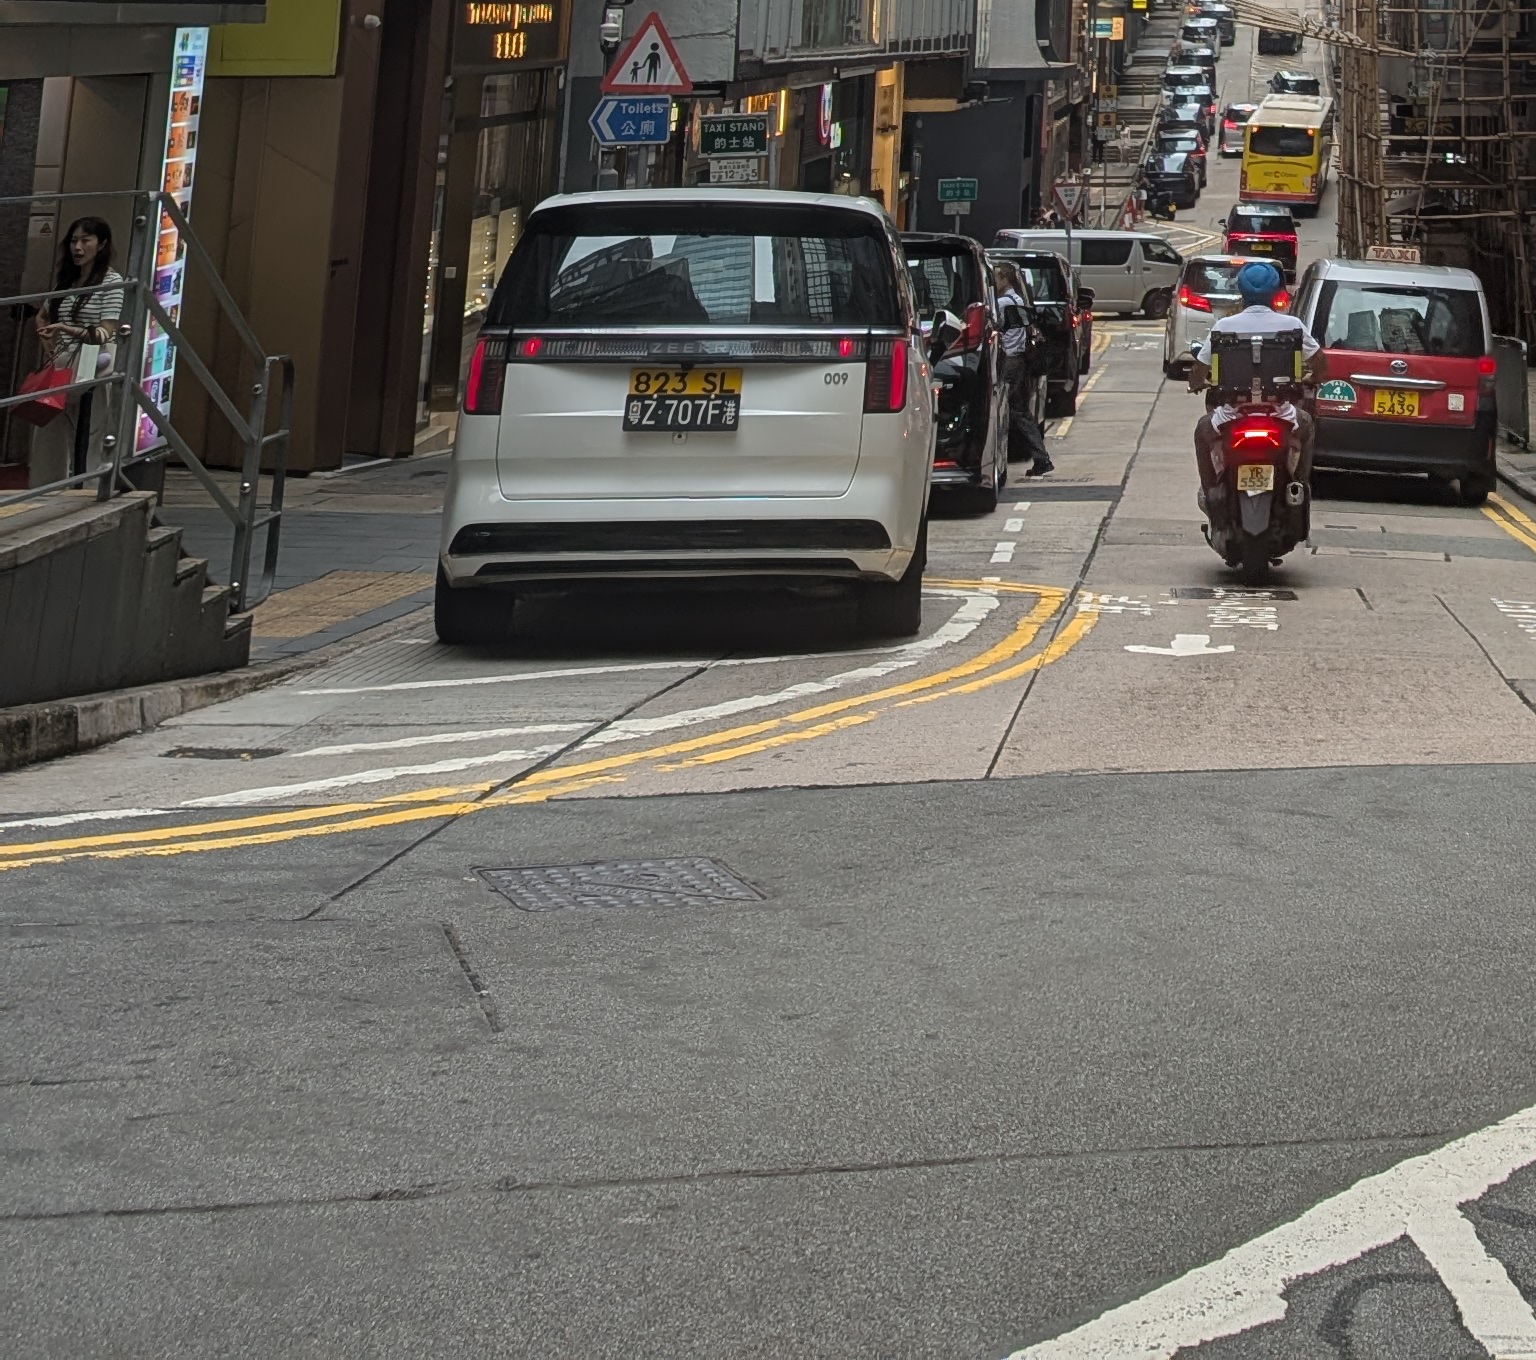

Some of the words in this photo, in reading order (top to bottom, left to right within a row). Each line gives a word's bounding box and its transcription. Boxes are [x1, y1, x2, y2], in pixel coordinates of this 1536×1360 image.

[620, 102, 665, 115] Toilets
[703, 123, 726, 134] TAXI
[729, 121, 766, 133] STAND
[714, 135, 755, 150] 的士站
[1373, 247, 1416, 261] TAXI
[634, 372, 688, 394] 823
[702, 372, 736, 394] SL
[824, 372, 849, 385] 009
[1388, 390, 1406, 406] YS
[1377, 401, 1416, 418] 5439
